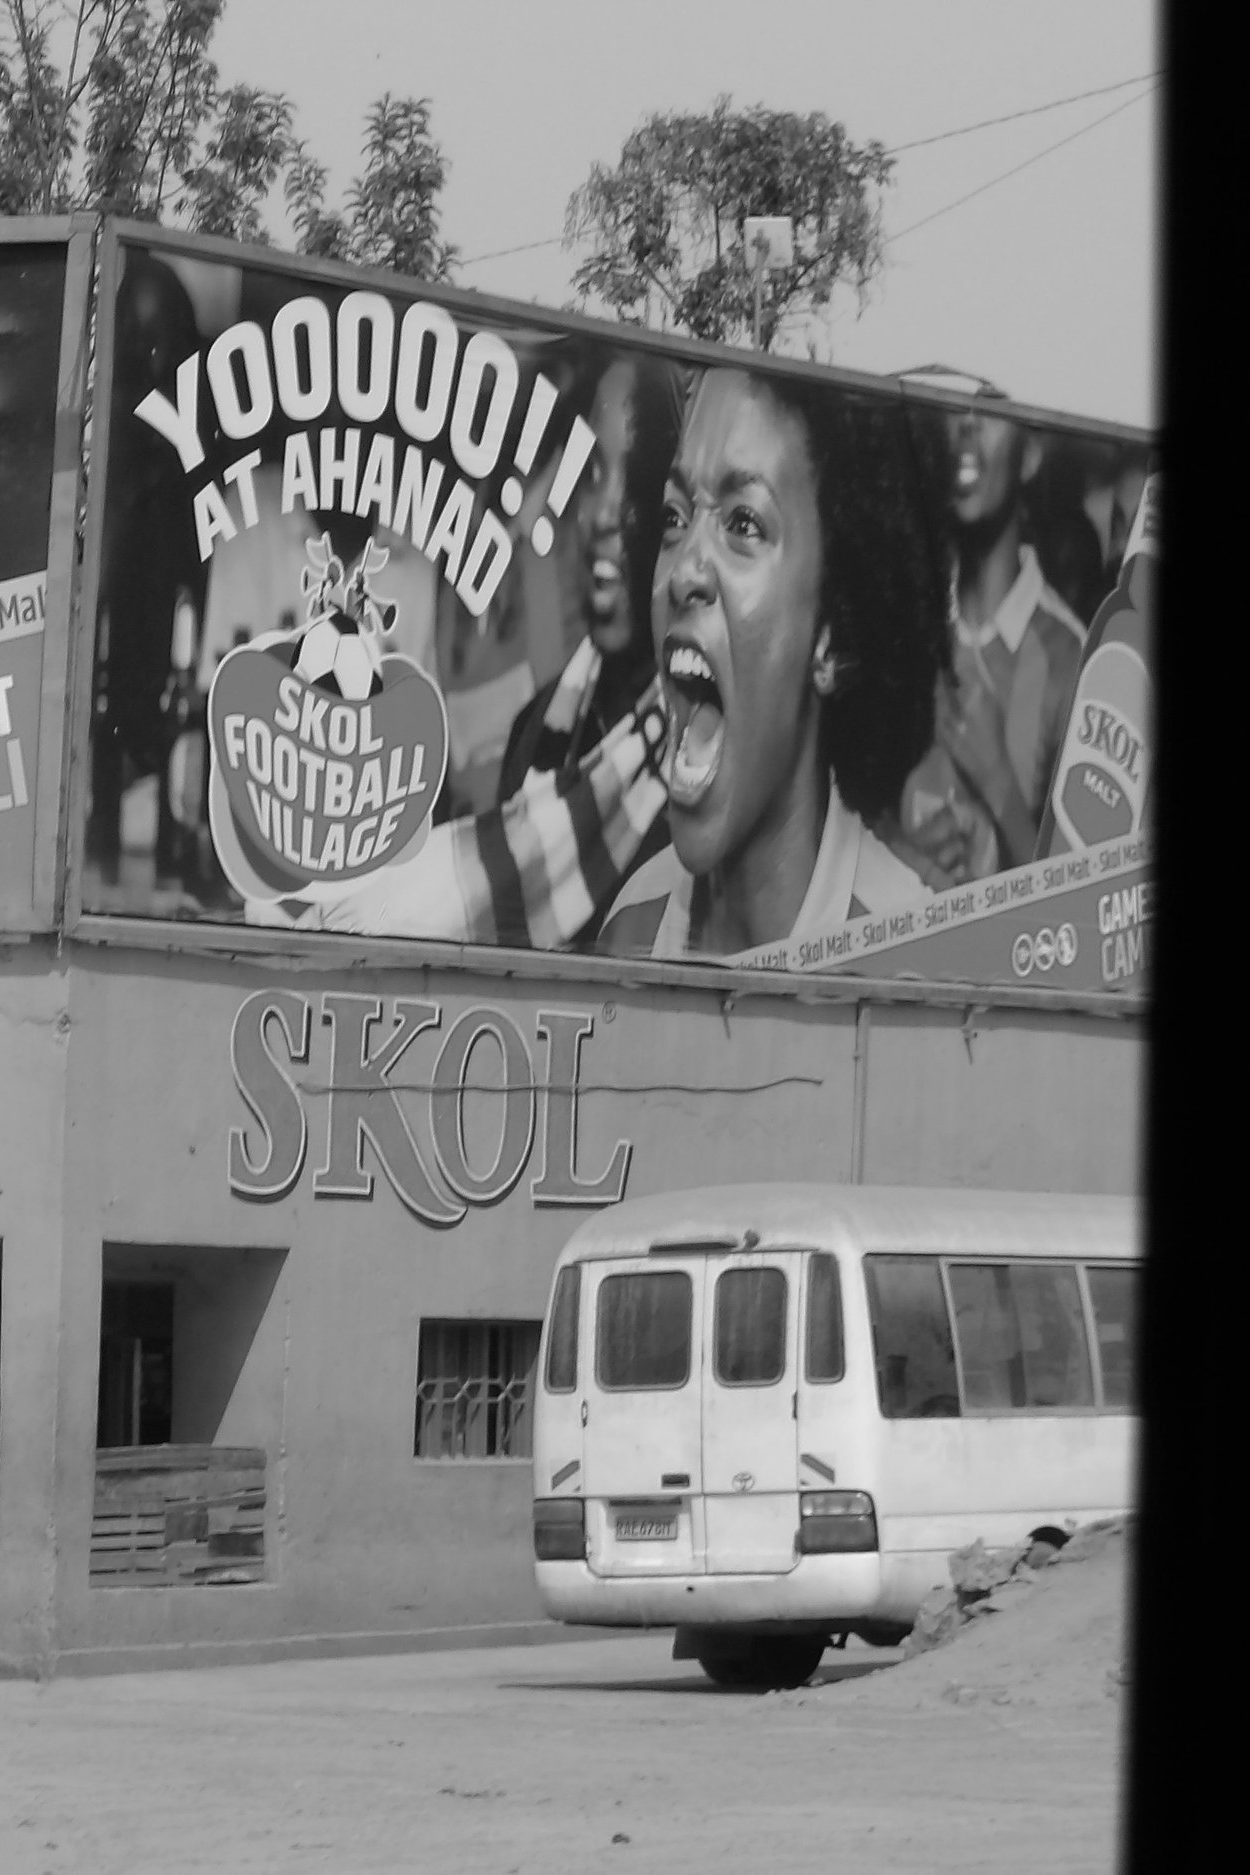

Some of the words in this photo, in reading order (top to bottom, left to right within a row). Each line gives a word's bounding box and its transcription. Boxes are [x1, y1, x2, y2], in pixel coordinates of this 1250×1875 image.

[133, 290, 597, 557] YOOOOO!!
[193, 448, 262, 562] AT
[281, 427, 513, 617] AHANAD
[224, 713, 427, 818] FOOTBALL
[274, 675, 384, 757] SKOL
[1078, 703, 1143, 784] SKOL
[246, 779, 407, 872] VILLAGE
[1083, 769, 1122, 809] MALT
[800, 936, 824, 967] Skol
[827, 929, 851, 958] Malt
[863, 918, 887, 947] Skol
[890, 911, 914, 940] Malt
[925, 901, 948, 928] Skol
[952, 891, 975, 919] Malt
[984, 881, 1008, 908] Skol
[1010, 873, 1034, 900] Malt
[1043, 863, 1066, 890] Skol
[1067, 857, 1090, 884] Malt
[228, 988, 633, 1230] SKOL
